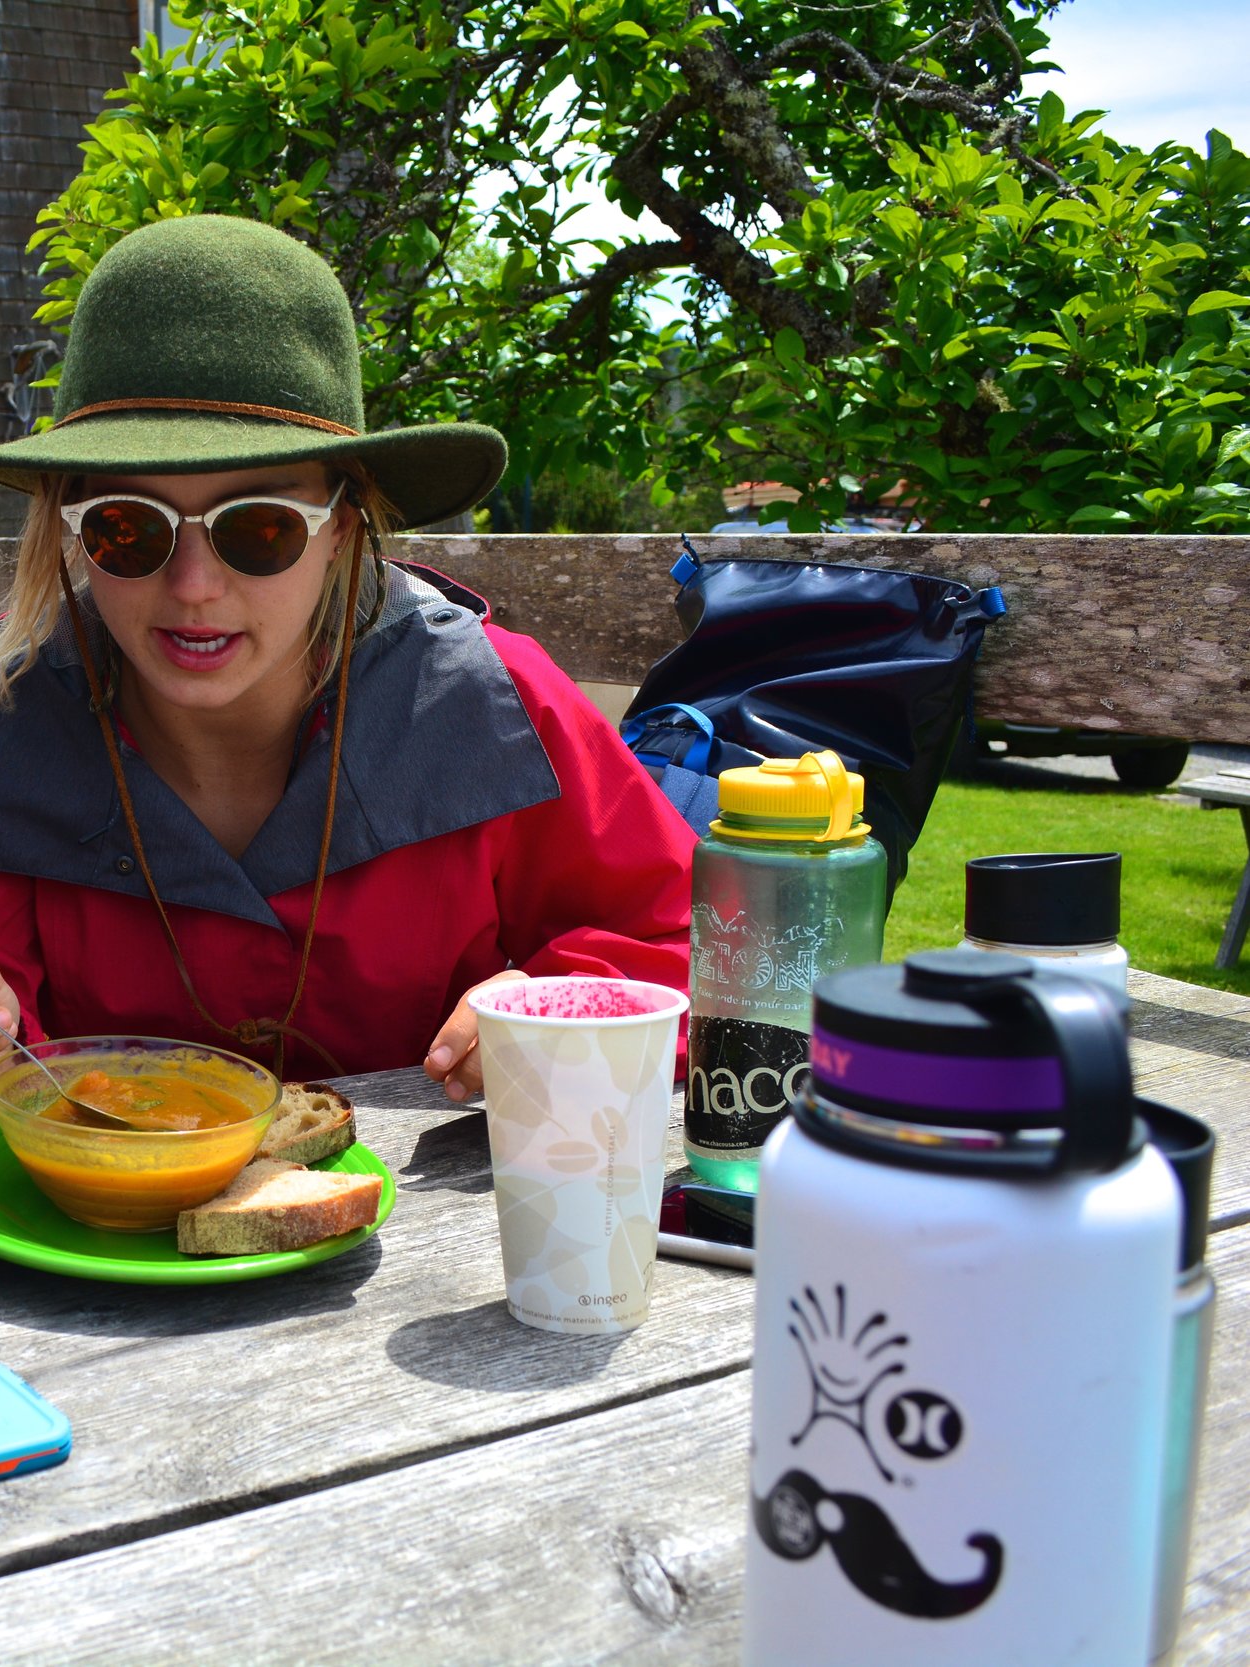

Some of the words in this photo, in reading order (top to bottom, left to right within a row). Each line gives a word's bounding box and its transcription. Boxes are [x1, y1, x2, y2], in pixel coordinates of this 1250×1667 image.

[716, 994, 739, 1005] ride
[741, 996, 751, 1006] in
[754, 999, 781, 1010] your
[685, 1036, 813, 1115] hac
[606, 1124, 617, 1189] COMPOSTABLE
[604, 1191, 614, 1238] CERTIFIED
[521, 1307, 561, 1322] sustainable
[563, 1316, 602, 1325] materials
[593, 1293, 628, 1308] ingeo
